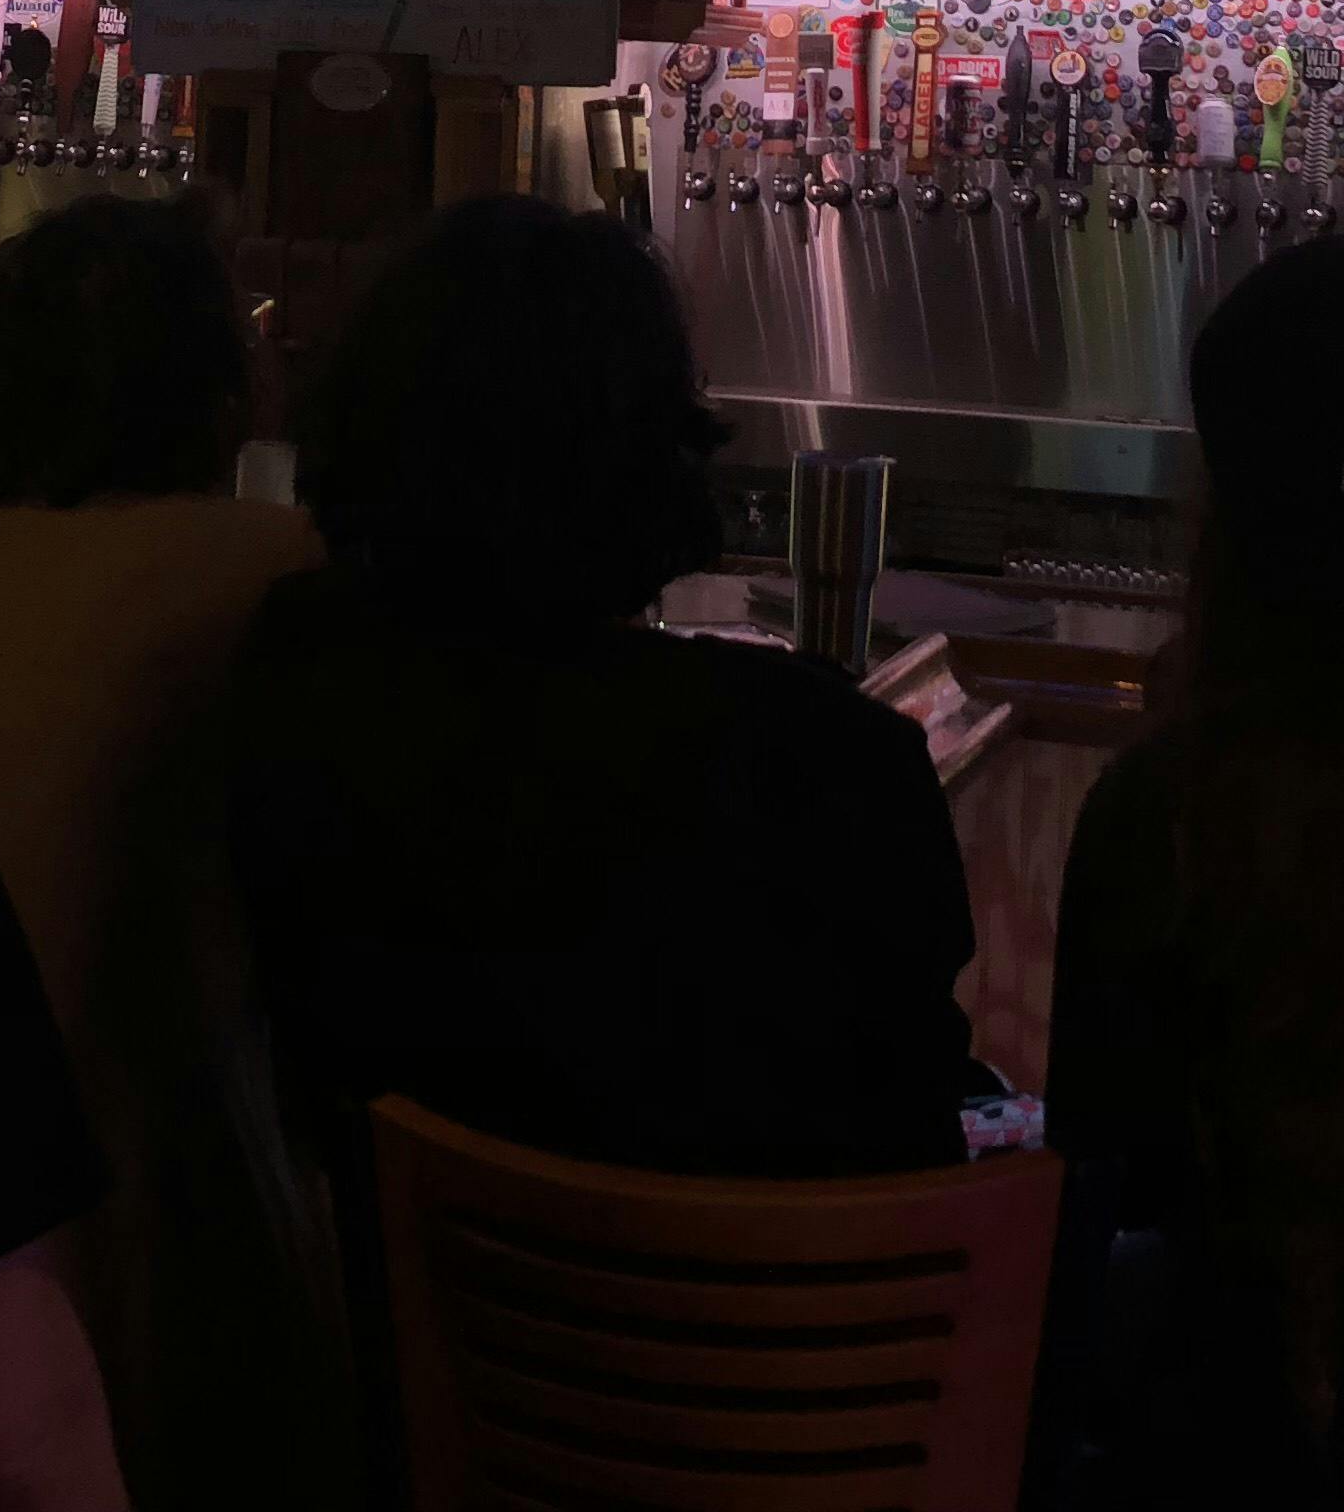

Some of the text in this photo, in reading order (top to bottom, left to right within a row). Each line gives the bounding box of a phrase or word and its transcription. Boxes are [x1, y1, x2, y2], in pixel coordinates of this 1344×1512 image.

[97, 21, 126, 35] SOUR
[1305, 66, 1340, 80] SOUR
[916, 70, 932, 141] LAGER
